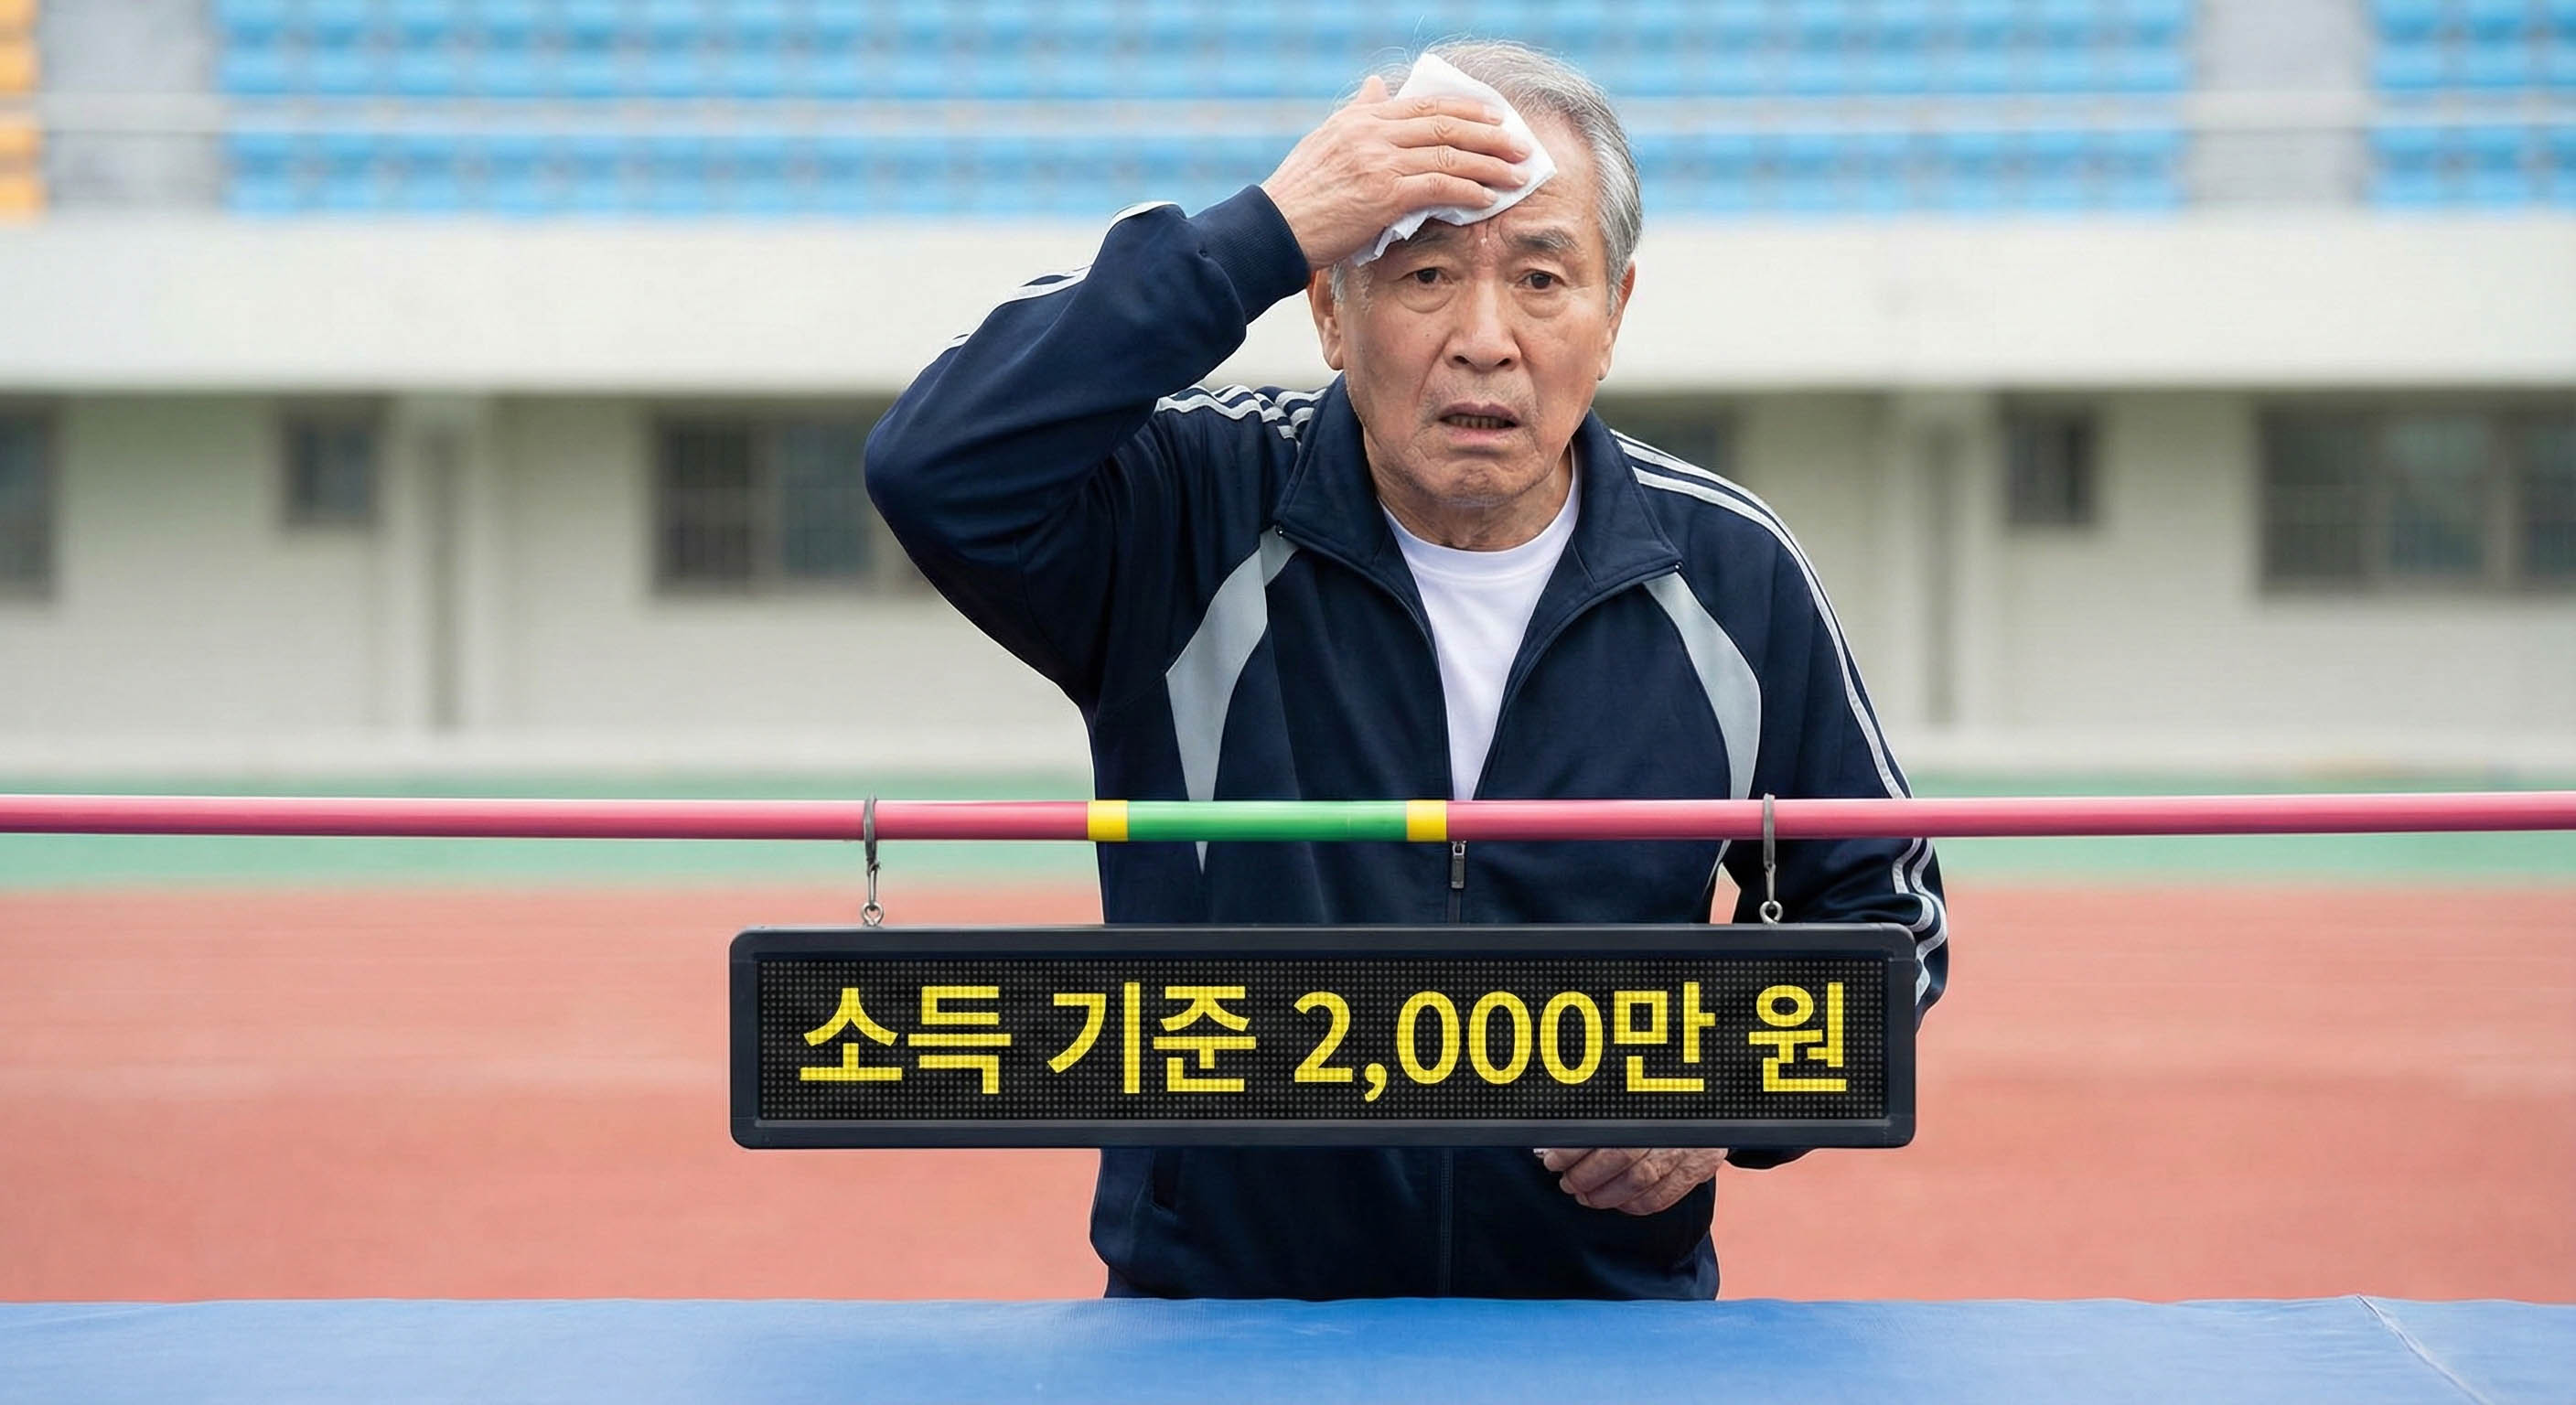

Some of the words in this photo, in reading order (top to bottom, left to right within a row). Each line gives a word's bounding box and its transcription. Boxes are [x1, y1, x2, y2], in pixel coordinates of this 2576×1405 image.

[799, 986, 1013, 1096] 소득
[1046, 981, 1258, 1095] 기준
[1293, 981, 1716, 1103] 2,000만
[1747, 981, 1848, 1093] 원
